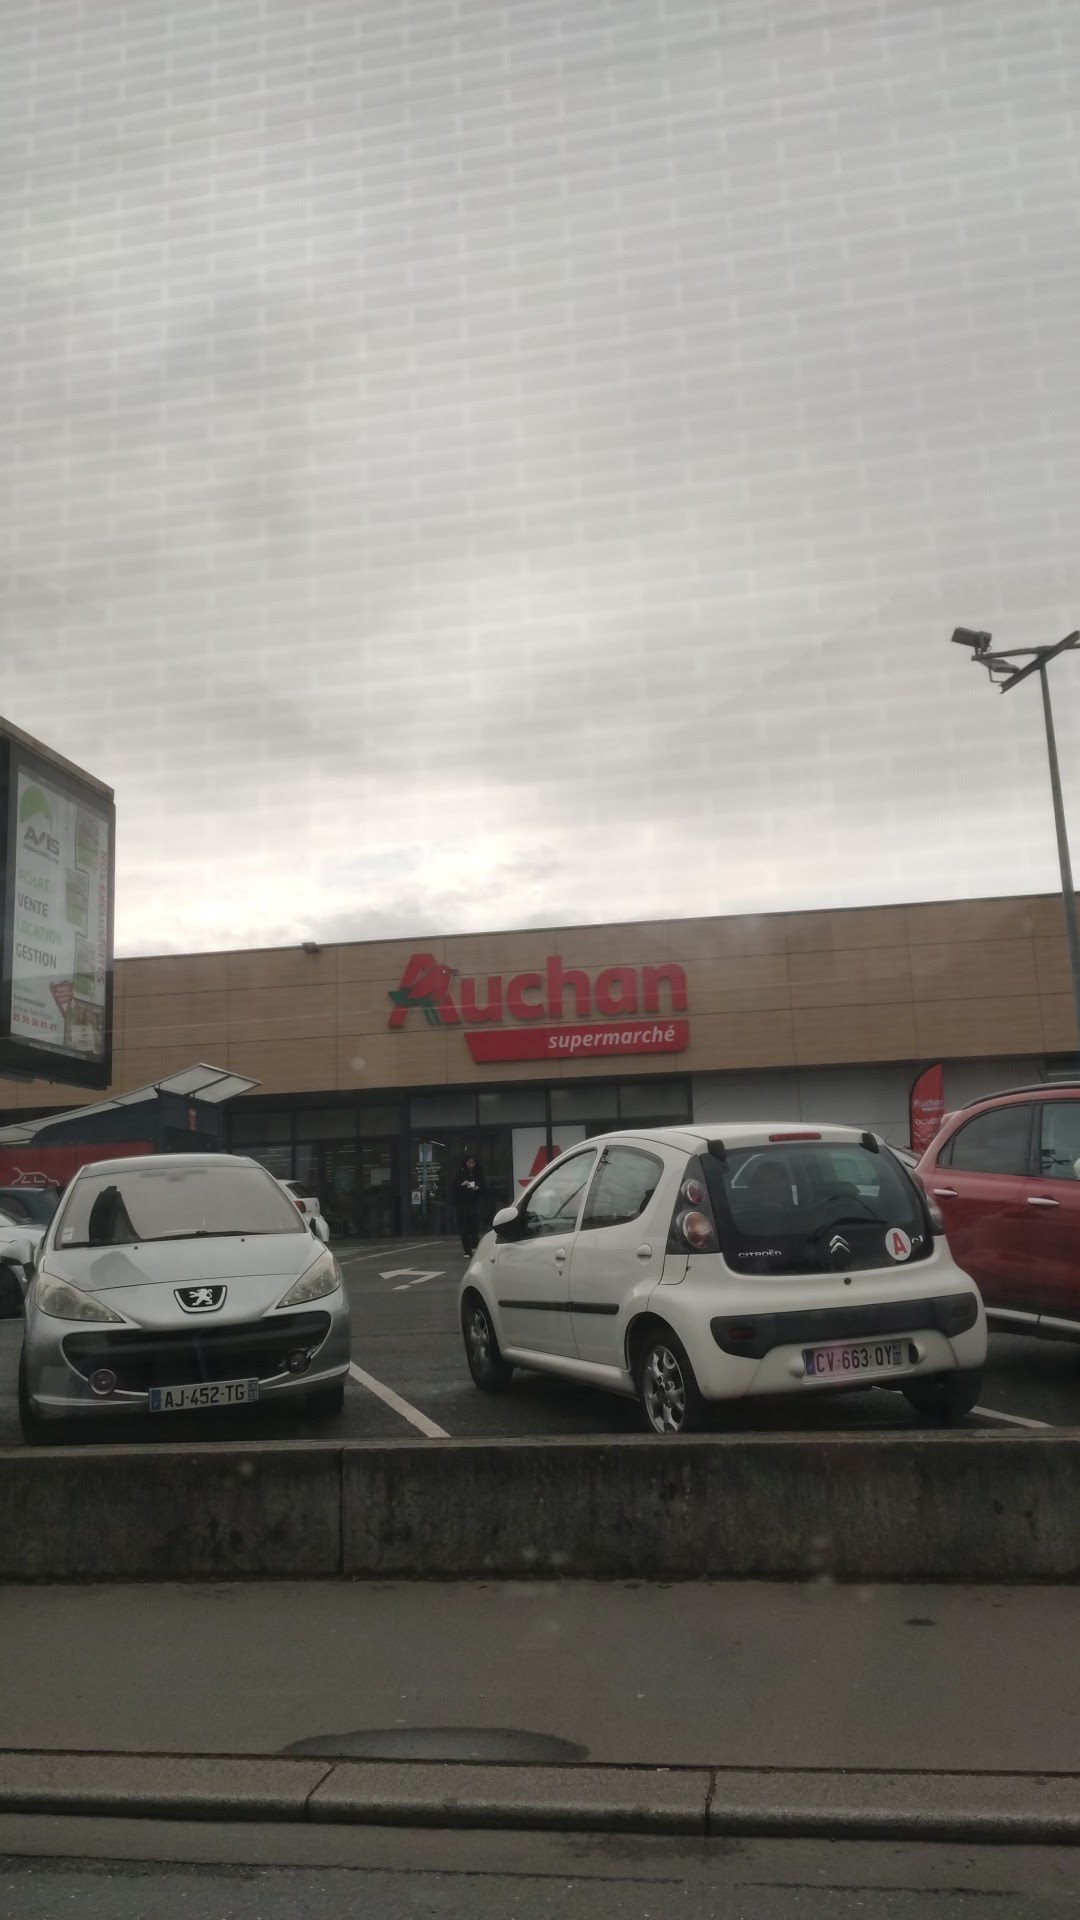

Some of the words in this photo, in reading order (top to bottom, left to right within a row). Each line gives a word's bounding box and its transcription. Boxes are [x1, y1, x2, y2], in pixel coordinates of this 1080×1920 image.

[23, 826, 60, 856] AVIS
[17, 868, 50, 892] ACHAT
[17, 892, 49, 917] VENTE
[15, 916, 63, 945] LOCATION
[15, 943, 57, 969] GESTION
[387, 953, 689, 1028] Auchan
[548, 1025, 676, 1052] supermarché
[892, 1232, 908, 1255] A
[164, 1384, 245, 1408] AJ-452-TG
